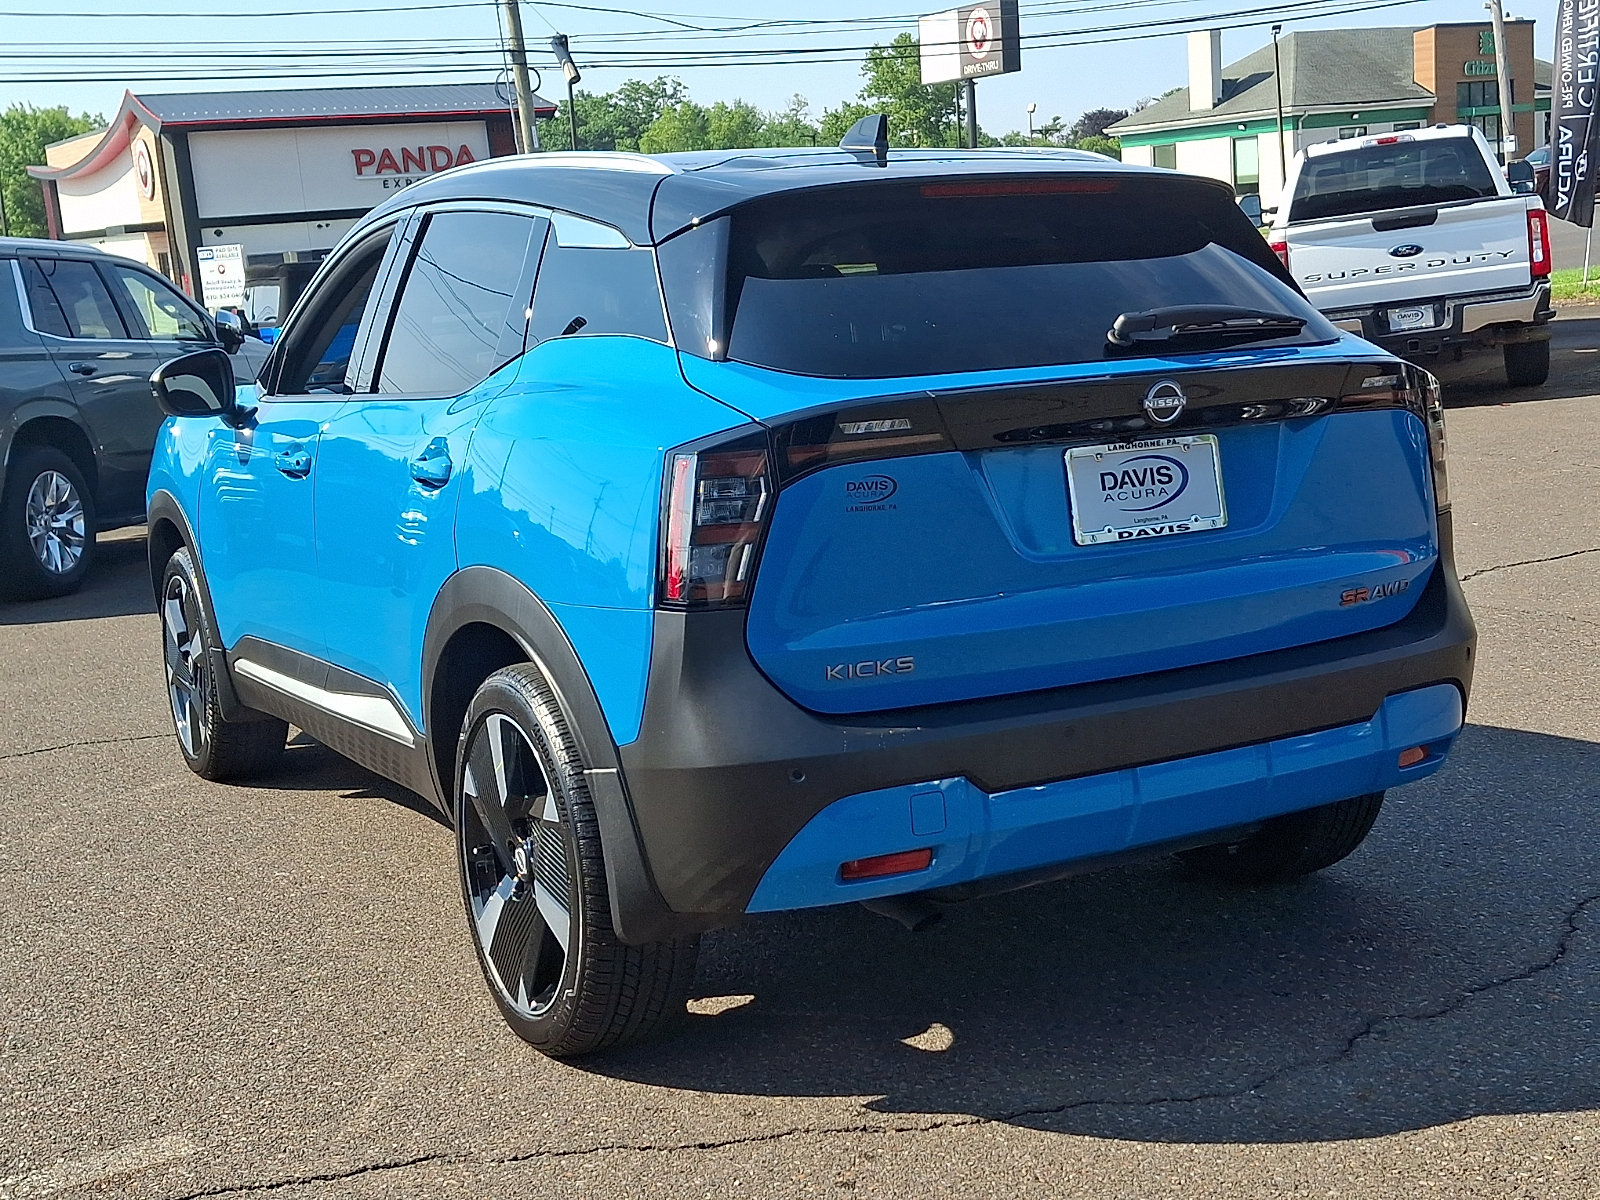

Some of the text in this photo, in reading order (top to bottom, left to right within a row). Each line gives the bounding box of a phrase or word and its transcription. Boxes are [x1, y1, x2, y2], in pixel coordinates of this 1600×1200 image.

[963, 60, 999, 75] DRIVE-THRU
[351, 144, 476, 176] PANDA
[1303, 250, 1515, 284] SUPER DUTY
[1397, 312, 1419, 320] DAVIS
[1144, 396, 1186, 409] NISSAN
[846, 480, 889, 492] DAVIS
[1100, 465, 1173, 491] DAVIS
[845, 490, 885, 499] ACURA
[1103, 486, 1169, 502] ACURA
[1117, 523, 1191, 540] DAVIS
[1339, 579, 1410, 606] SR AWD
[825, 655, 915, 681] KICKS
